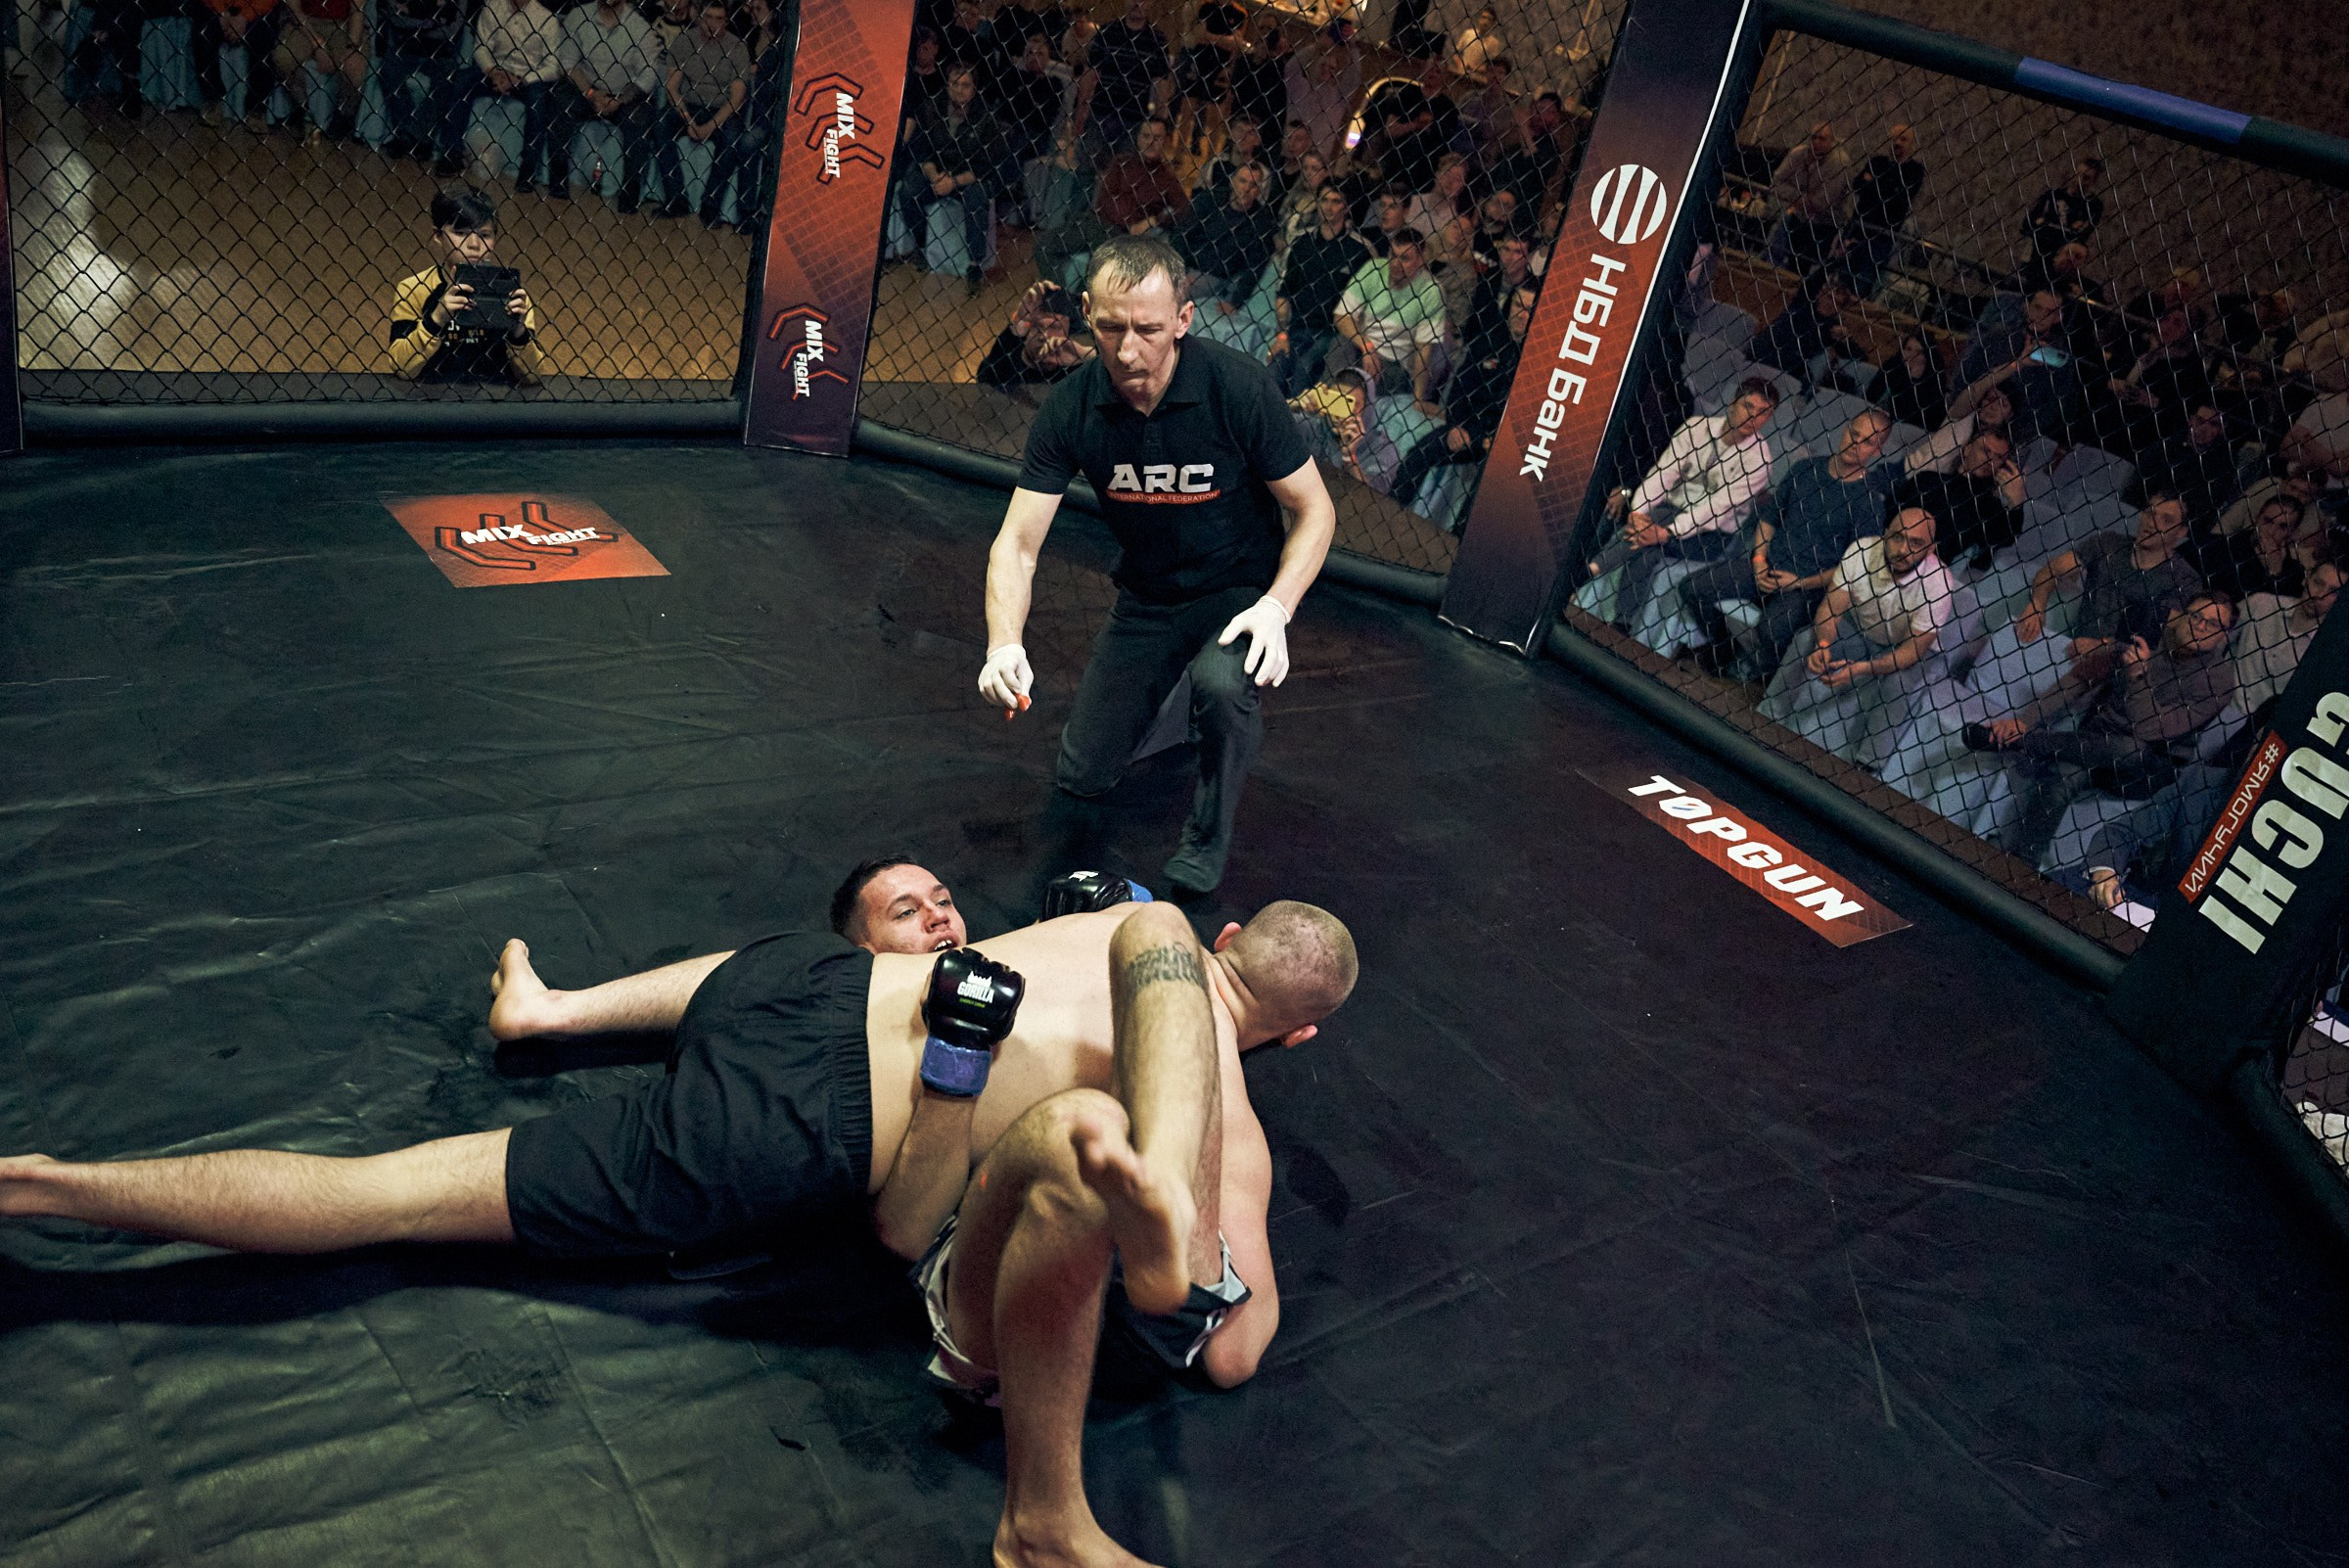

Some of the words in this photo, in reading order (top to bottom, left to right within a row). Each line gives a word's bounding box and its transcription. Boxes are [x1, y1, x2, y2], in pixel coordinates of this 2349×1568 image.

[835, 92, 856, 139] MIX
[826, 128, 841, 178] FIGHT
[1558, 253, 1627, 366] НБД
[805, 320, 824, 362] MIX
[796, 352, 810, 397] FIGHT
[1519, 367, 1588, 483] Банк
[1107, 463, 1215, 493] ARC
[1107, 491, 1169, 503] INTERNATONAL
[1169, 491, 1219, 503] FEDERATION
[460, 524, 534, 545] MIX
[528, 527, 601, 546] FIGHT
[2185, 742, 2280, 894] #ЯМОГУЧИЙ
[1628, 774, 1865, 921] TOPGUN
[956, 981, 995, 1004] GORILLA
